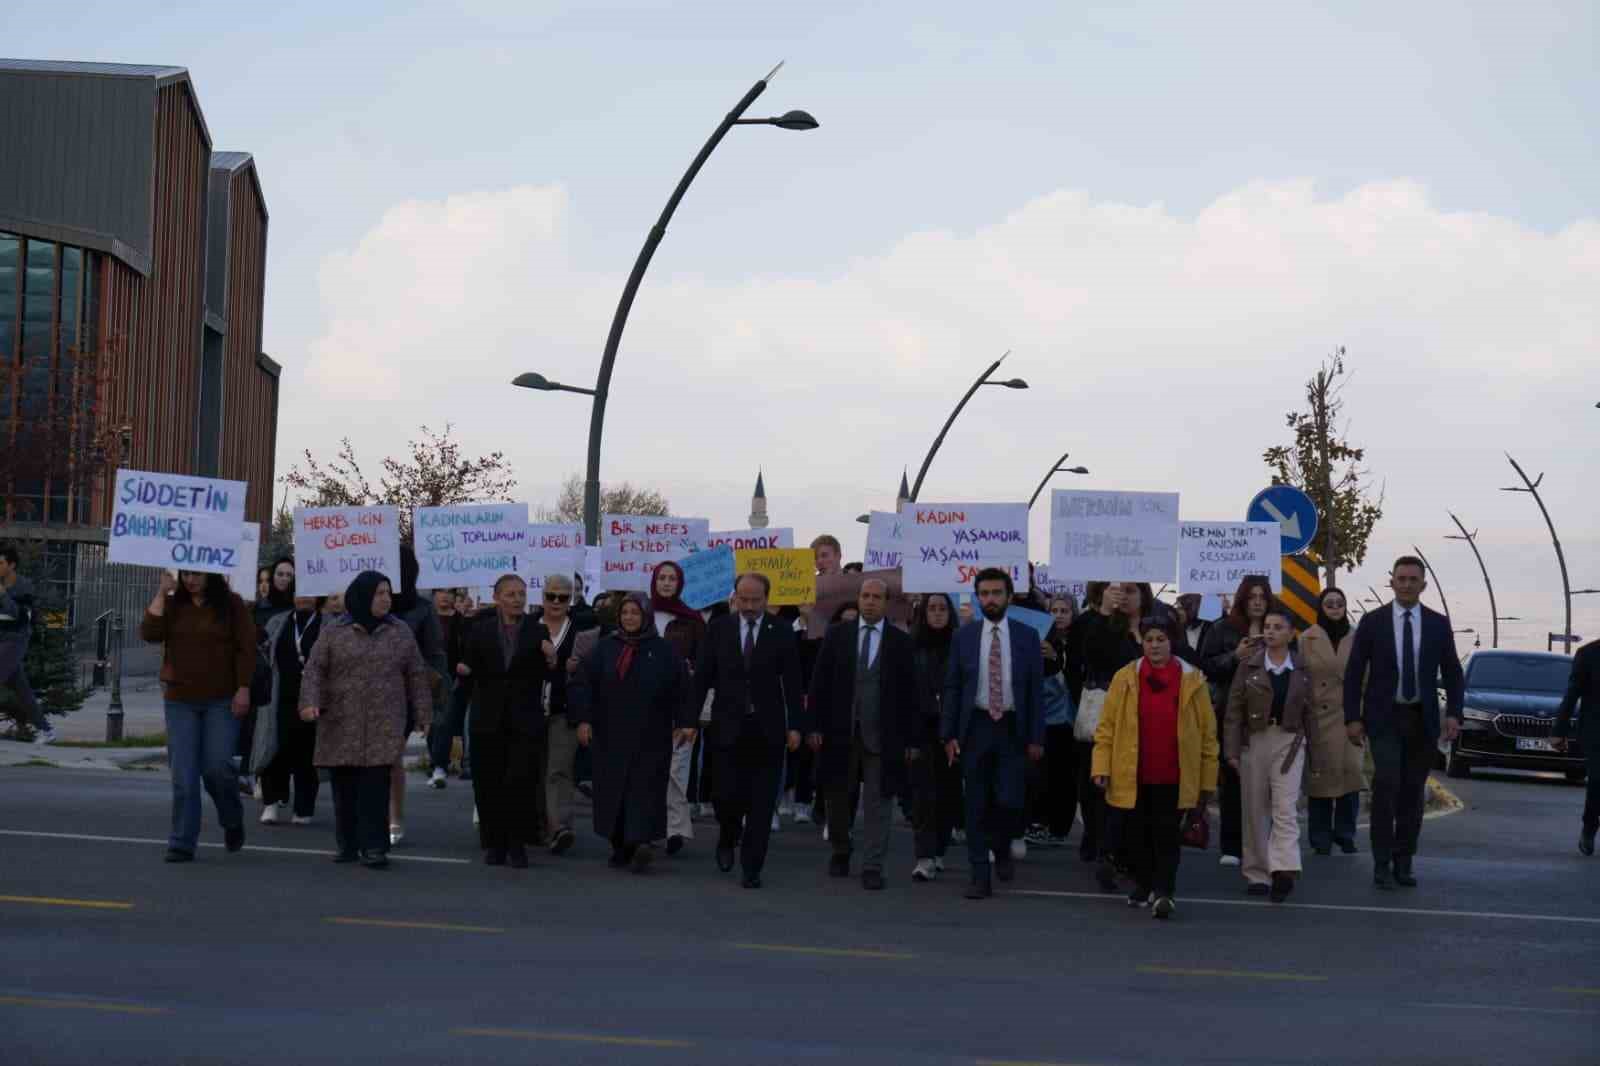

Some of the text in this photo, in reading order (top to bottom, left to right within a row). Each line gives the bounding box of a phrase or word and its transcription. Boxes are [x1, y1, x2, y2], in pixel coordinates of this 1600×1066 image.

[121, 477, 229, 513] ŞİDDETİN
[916, 510, 966, 525] KADIN
[461, 529, 525, 545] TOPLUMUN
[646, 522, 689, 536] NEFES
[171, 543, 238, 568] OLMAZ
[919, 545, 980, 566] YAŞAMI
